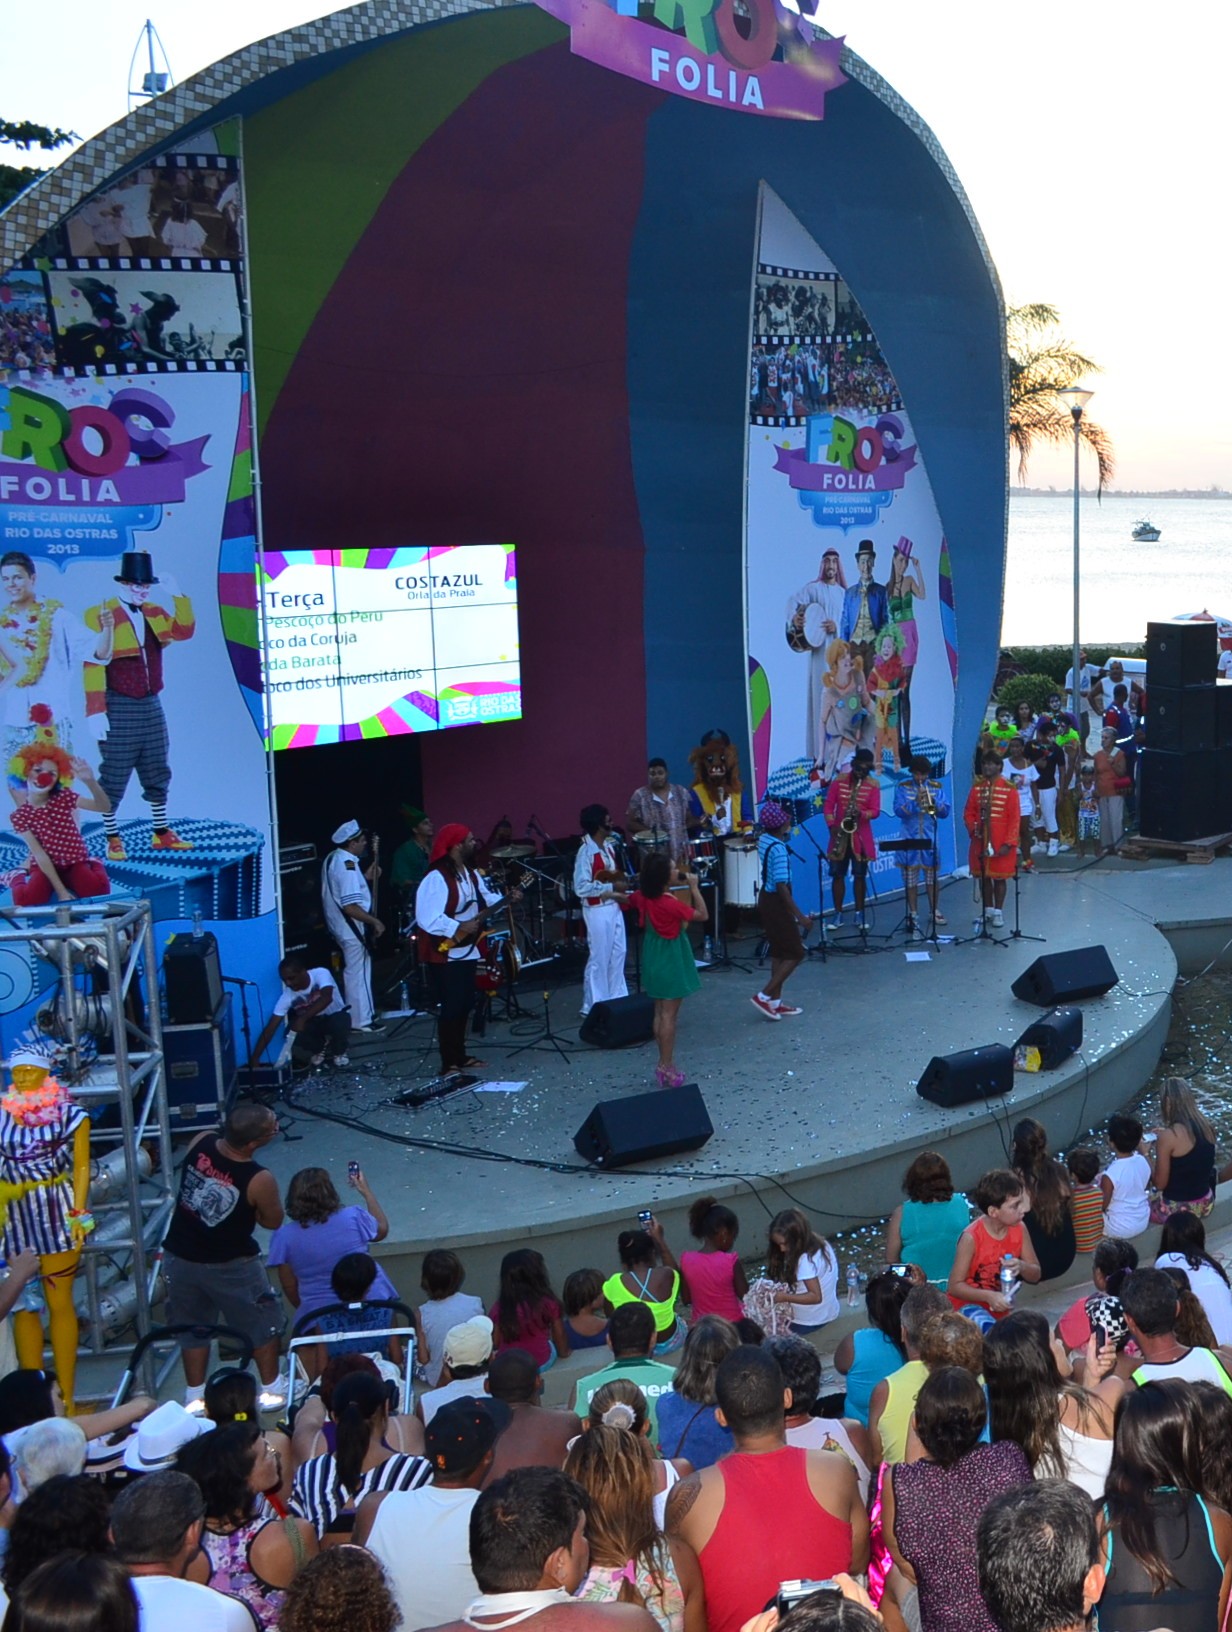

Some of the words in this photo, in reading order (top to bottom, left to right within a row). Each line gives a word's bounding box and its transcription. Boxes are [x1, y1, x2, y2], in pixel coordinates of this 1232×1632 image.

[651, 47, 764, 110] FOLIA
[1, 476, 121, 502] FOLIA
[823, 473, 876, 489] FOLIA
[5, 527, 30, 538] RIO
[33, 528, 61, 538] DAS
[64, 528, 118, 539] OSTRAS
[47, 544, 80, 554] 2013
[395, 574, 483, 590] COSTAZUL
[266, 591, 325, 611] Terça
[407, 591, 429, 600] Orla
[433, 591, 446, 599] da
[449, 589, 475, 598] Praia
[328, 611, 347, 625] do
[351, 610, 384, 623] Peru
[288, 635, 307, 648] da
[310, 631, 357, 646] Coruja
[291, 655, 341, 669] Barata
[295, 677, 322, 691] dos
[325, 667, 423, 688] Universitários
